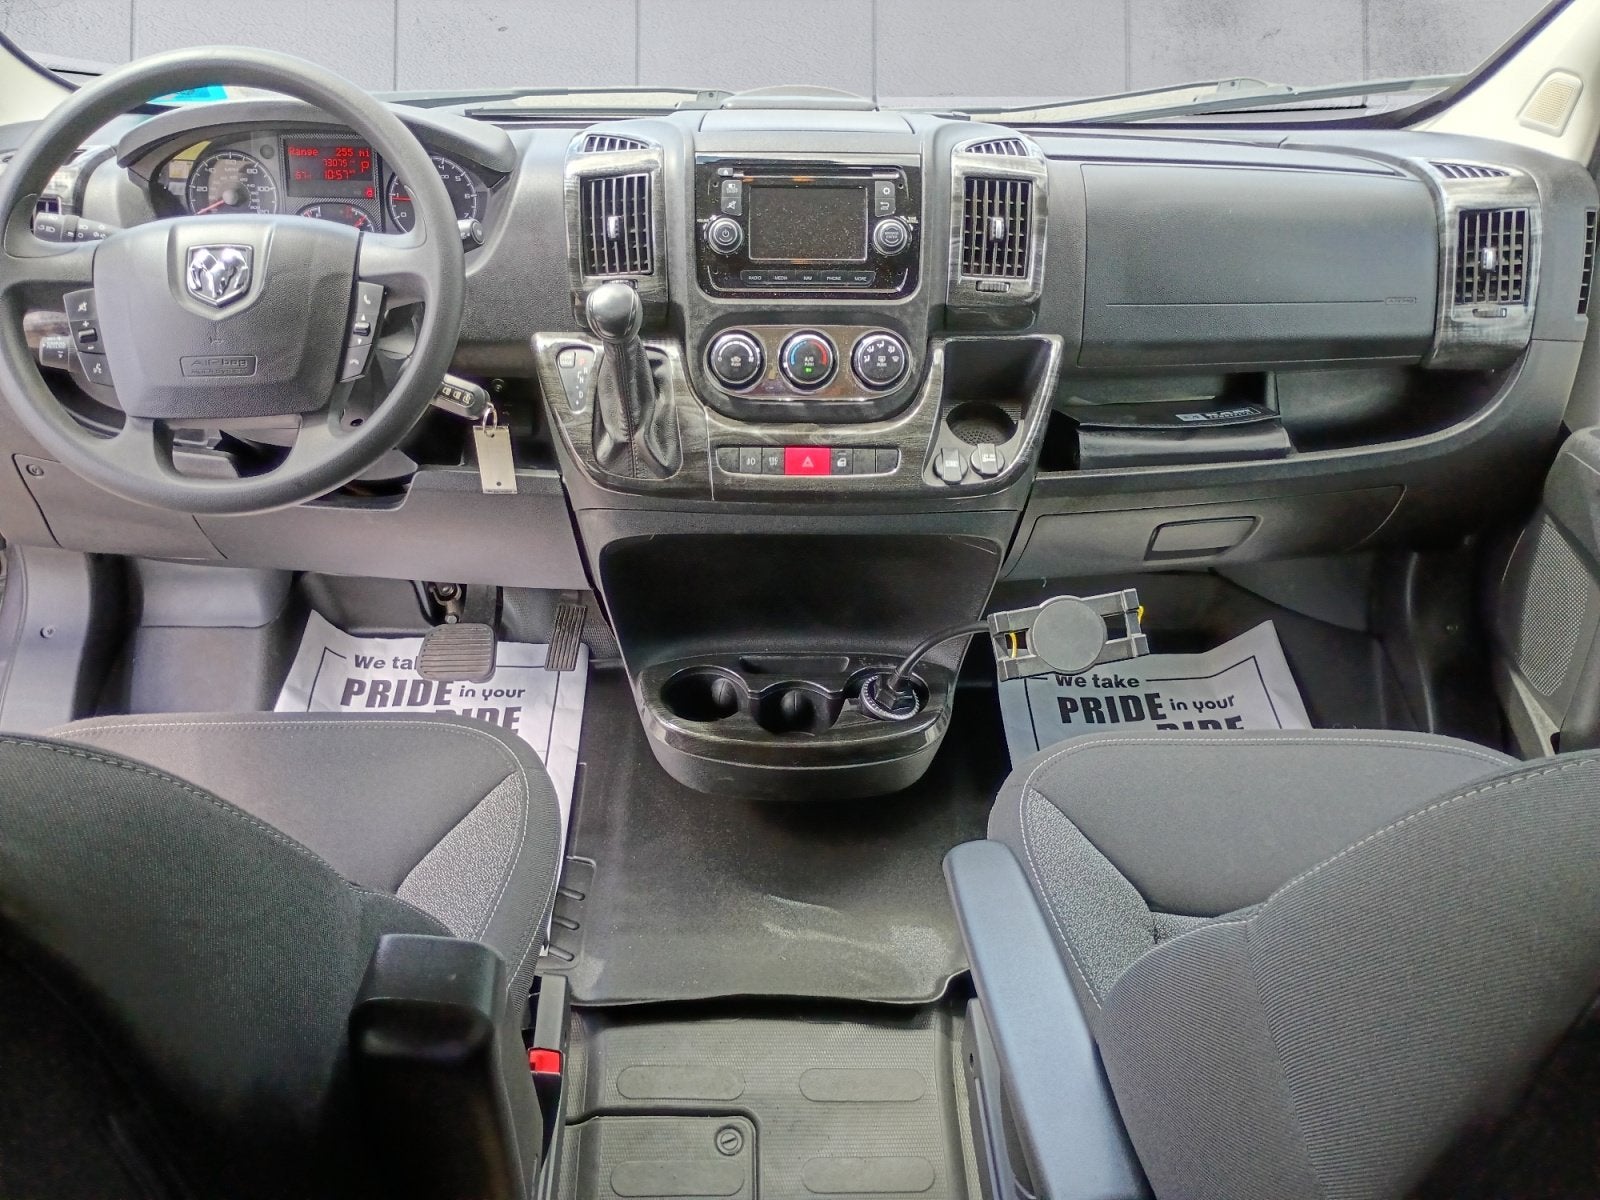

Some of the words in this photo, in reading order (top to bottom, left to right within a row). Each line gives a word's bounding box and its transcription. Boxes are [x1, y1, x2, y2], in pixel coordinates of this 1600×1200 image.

[288, 146, 318, 156] Range
[336, 147, 353, 157] 255
[354, 654, 386, 669] We
[392, 655, 418, 670] ta
[1055, 674, 1087, 687] We
[1092, 674, 1140, 689] take
[340, 678, 454, 708] PRIDE
[459, 685, 476, 698] in
[481, 687, 525, 701] your
[1057, 692, 1167, 724] PRIDE
[1169, 698, 1188, 711] in
[1192, 695, 1235, 713] your
